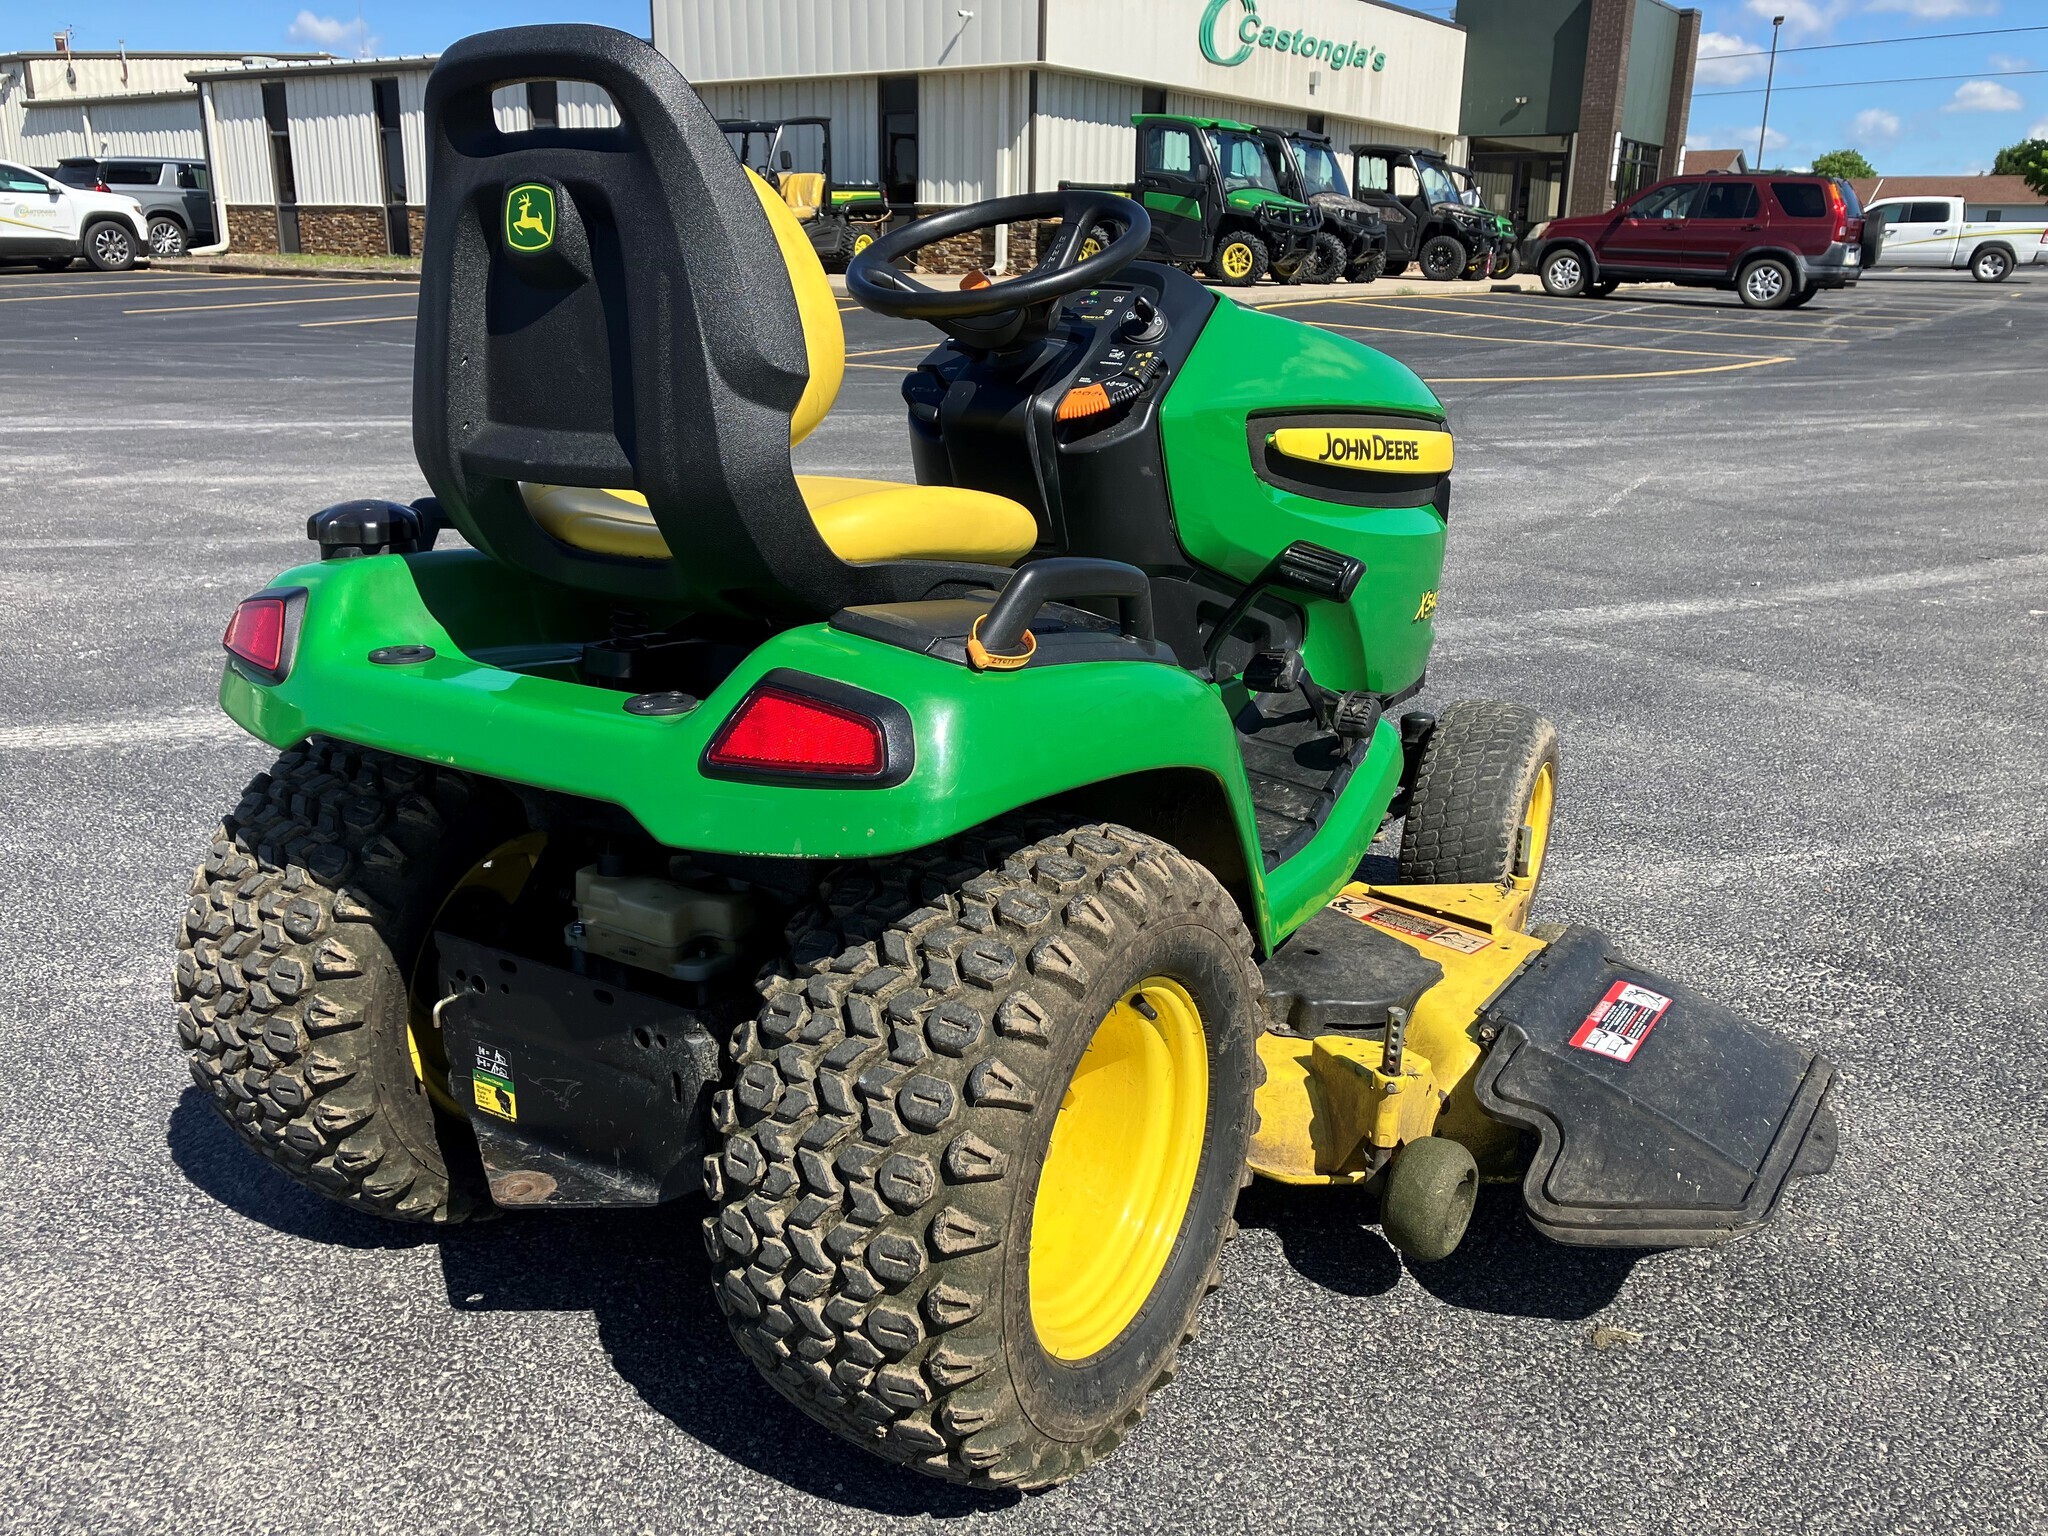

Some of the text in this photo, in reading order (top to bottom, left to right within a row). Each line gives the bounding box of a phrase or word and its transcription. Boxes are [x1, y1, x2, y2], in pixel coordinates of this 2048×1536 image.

[1239, 14, 1387, 72] Castongia's
[1319, 432, 1419, 461] JOHN DEERE
[1370, 918, 1410, 934] DANGER
